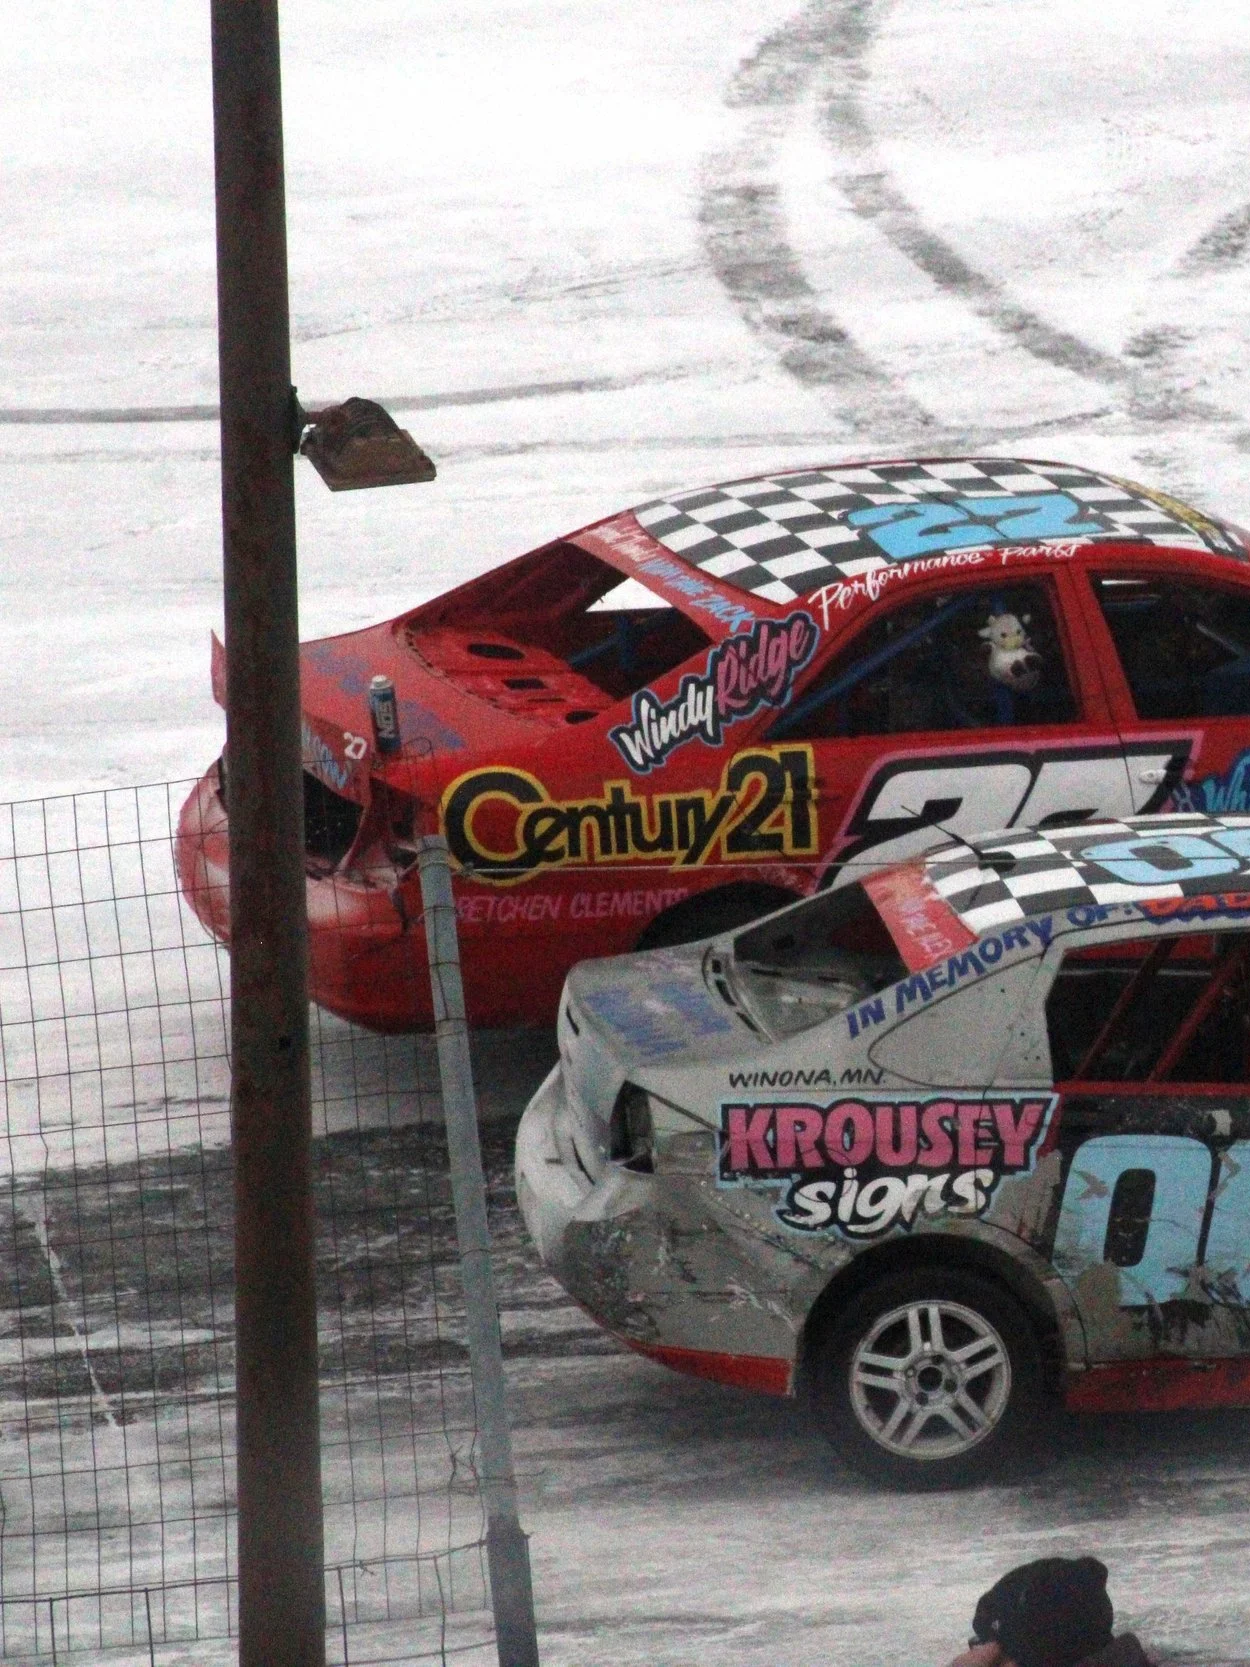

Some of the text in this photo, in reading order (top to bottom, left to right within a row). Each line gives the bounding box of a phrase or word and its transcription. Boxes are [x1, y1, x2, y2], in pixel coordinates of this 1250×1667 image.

[845, 493, 1105, 559] 22
[806, 551, 985, 632] Performance
[619, 619, 812, 766] Windy Ridge
[441, 744, 819, 885] Century 21
[845, 997, 887, 1040] IN
[895, 914, 1054, 1014] MEMORY
[727, 1101, 1045, 1170] KROUSEY
[780, 1166, 996, 1233] signs
